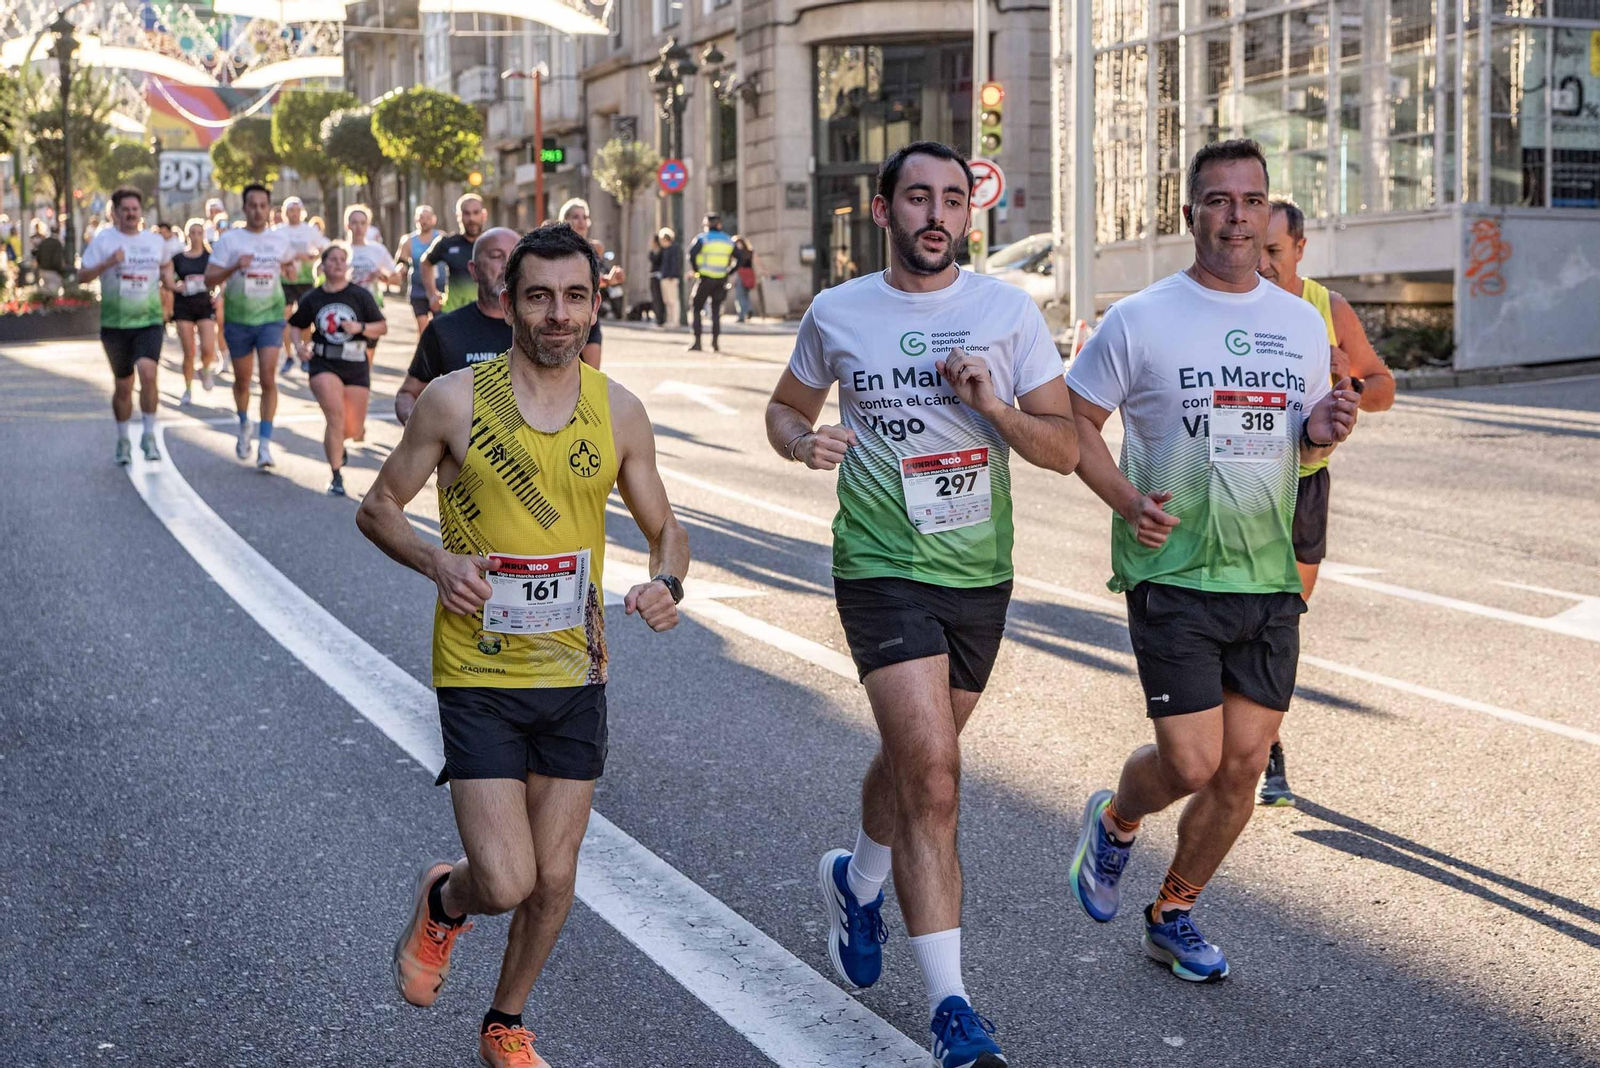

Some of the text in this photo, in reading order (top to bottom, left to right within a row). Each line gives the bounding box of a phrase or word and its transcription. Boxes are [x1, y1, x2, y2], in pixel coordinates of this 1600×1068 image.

[932, 338, 966, 346] española
[1254, 332, 1287, 342] asociación
[1255, 340, 1284, 348] española
[1285, 350, 1304, 360] cáncer
[853, 370, 884, 392] En
[1179, 366, 1306, 393] En Marcha
[860, 397, 902, 410] contra
[906, 395, 922, 406] el
[862, 414, 926, 442] Vigo
[1242, 412, 1274, 431] 318
[580, 466, 590, 476] 11
[935, 471, 978, 497] 297
[522, 580, 559, 600] 161
[460, 664, 506, 674] MAQUIEIRA
